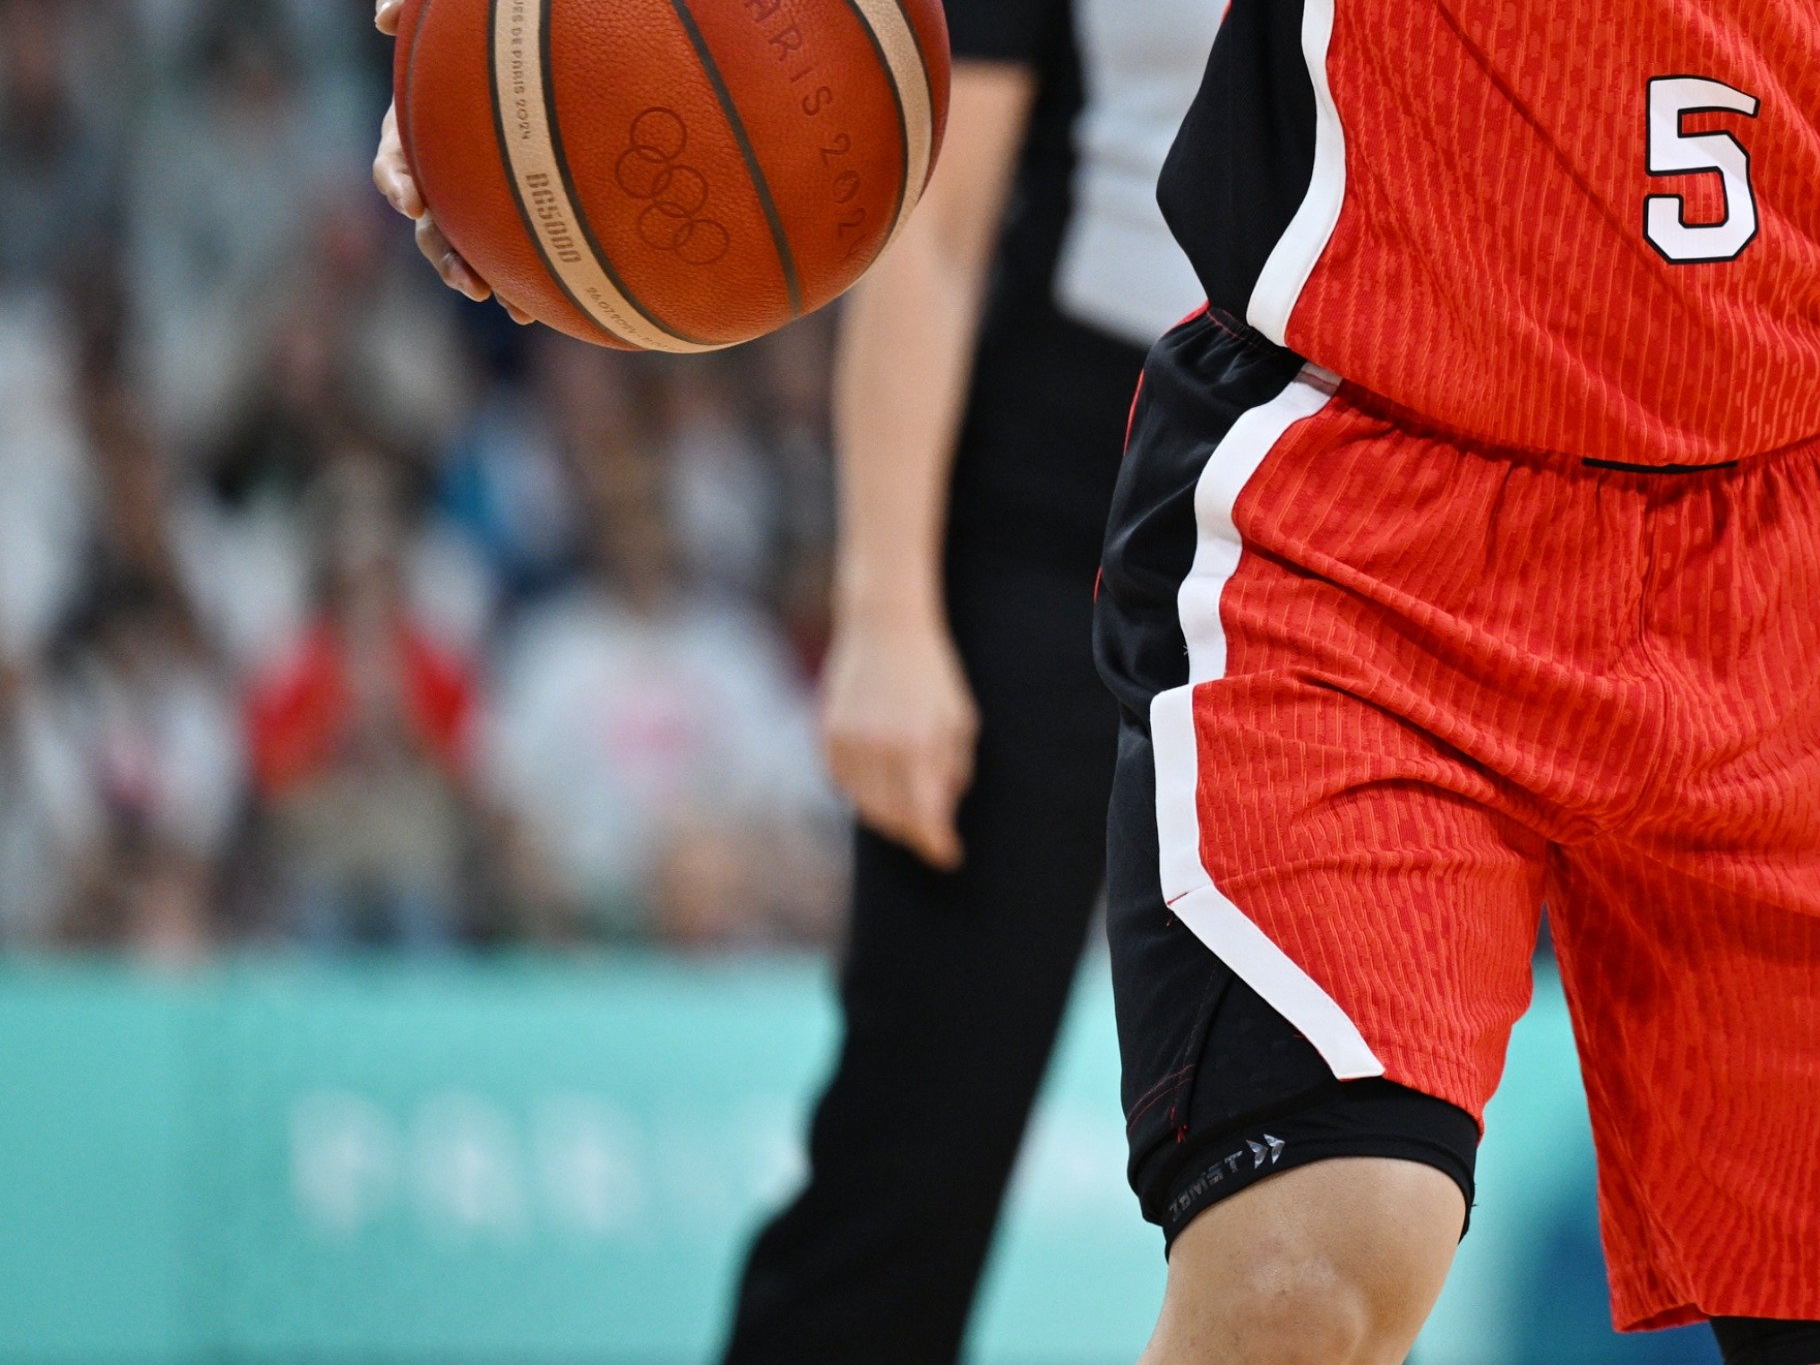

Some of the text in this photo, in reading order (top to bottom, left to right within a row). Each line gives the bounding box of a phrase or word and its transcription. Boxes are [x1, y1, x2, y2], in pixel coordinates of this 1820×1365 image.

[510, 27, 523, 45] DE
[511, 49, 525, 94] PARIS
[515, 98, 532, 140] 2024
[1643, 73, 1760, 265] 5
[525, 172, 582, 264] BG5000
